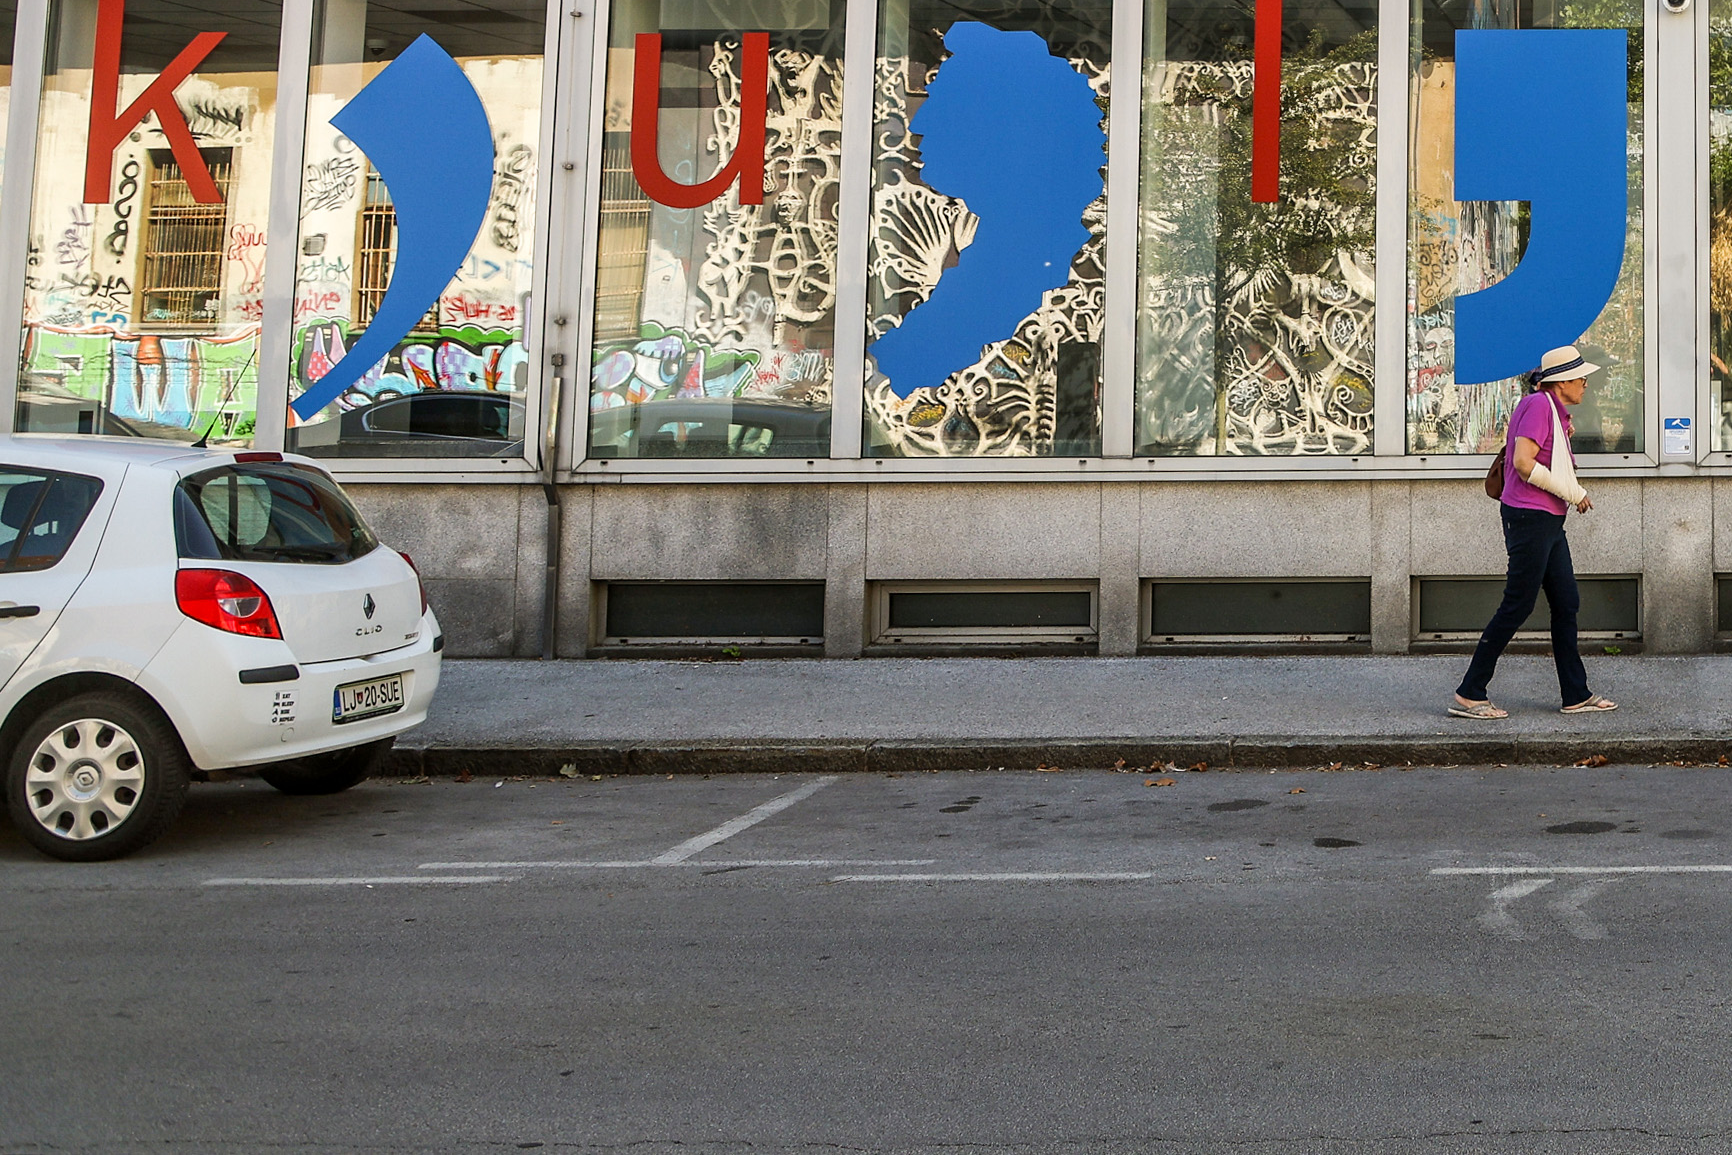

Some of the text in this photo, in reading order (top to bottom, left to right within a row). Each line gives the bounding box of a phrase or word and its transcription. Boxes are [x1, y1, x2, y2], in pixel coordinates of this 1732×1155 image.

[355, 624, 383, 636] CLIO
[342, 680, 400, 712] LJ 20-SUE
